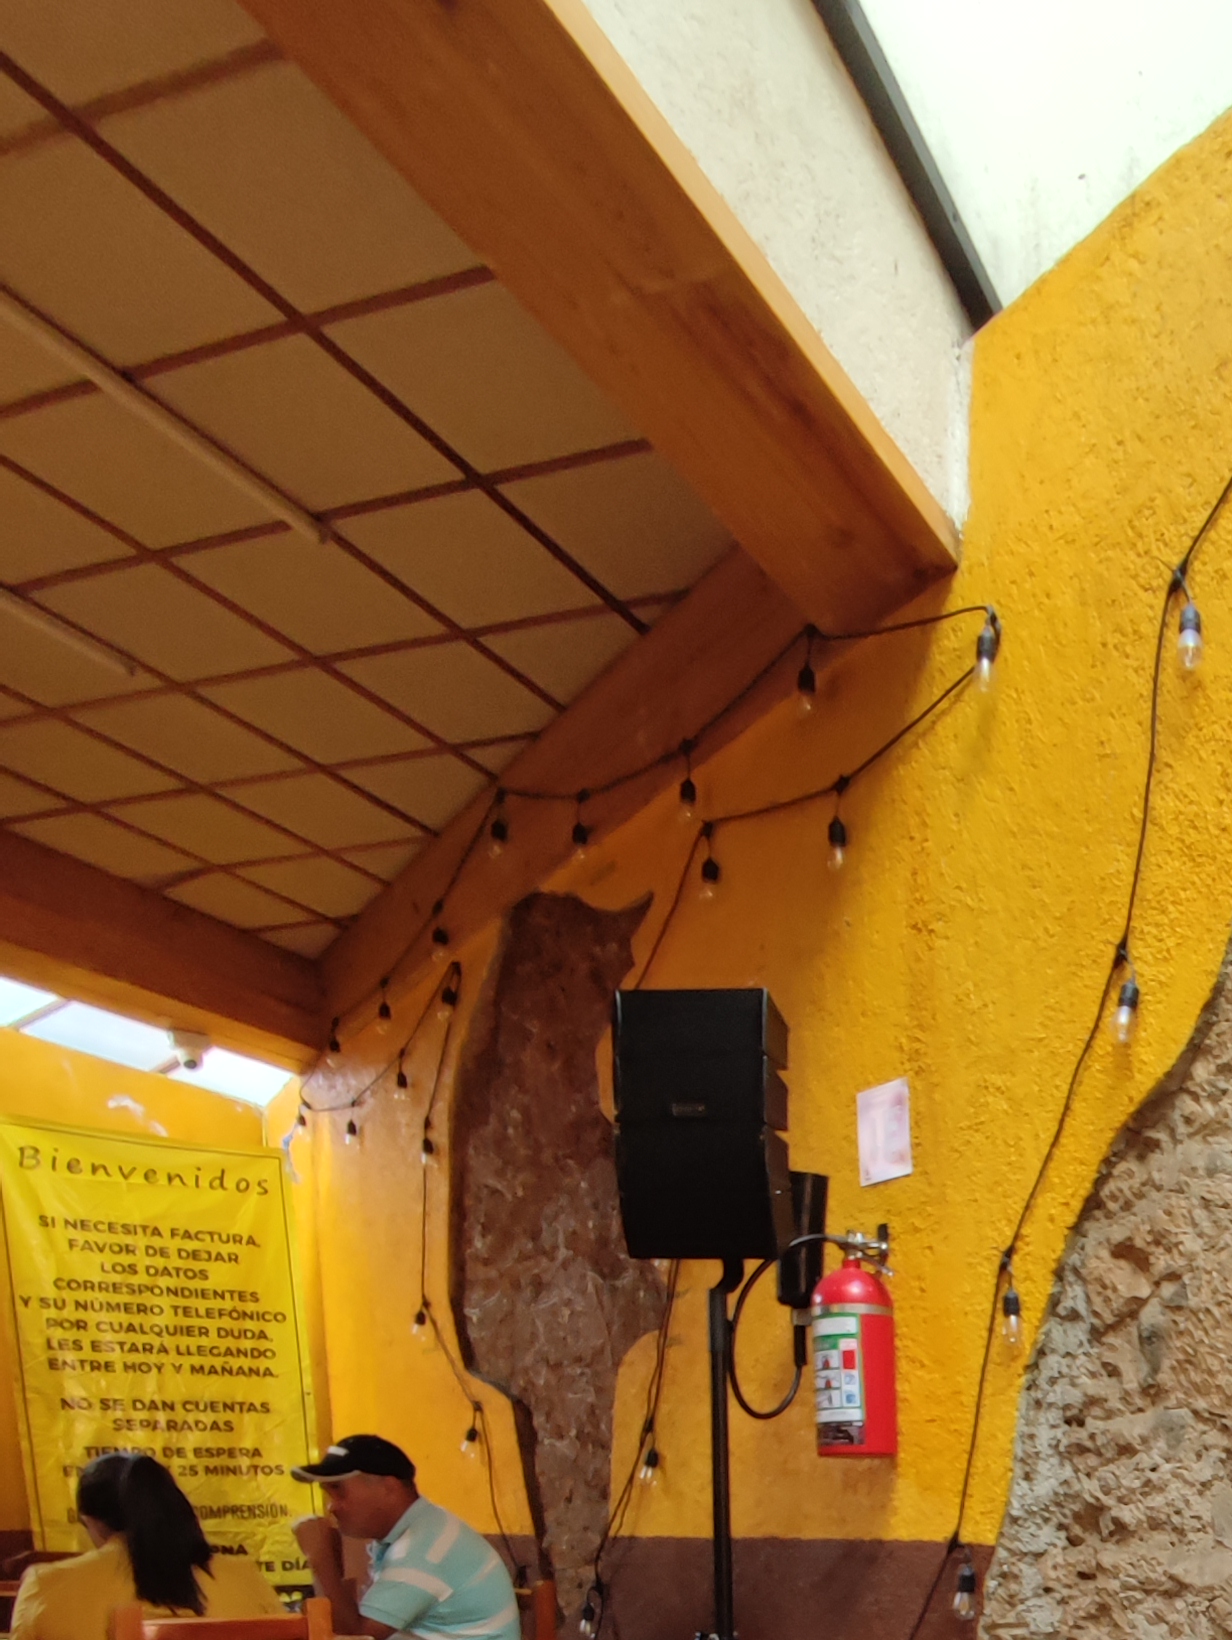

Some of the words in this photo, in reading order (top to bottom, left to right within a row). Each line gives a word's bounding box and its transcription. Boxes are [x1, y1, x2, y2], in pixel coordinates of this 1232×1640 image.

[18, 1145, 269, 1196] Bienvenidos
[38, 1214, 56, 1229] SI
[64, 1218, 164, 1239] NECESITA
[68, 1239, 138, 1257] FAVOR
[145, 1245, 171, 1259] DE
[177, 1249, 240, 1265] DEJAR
[100, 1262, 139, 1276] LOS
[145, 1265, 209, 1281] DATOS
[53, 1277, 260, 1303] CORRESPONDIENTES
[19, 1295, 31, 1309] Y
[39, 1297, 66, 1311] SU
[75, 1296, 164, 1317] NÚMERO
[171, 1305, 287, 1324] TELEFÓNICO
[45, 1317, 88, 1333] POR
[95, 1319, 210, 1338] CUALQUIER
[46, 1337, 84, 1352] LES
[90, 1339, 170, 1356] ESTARÁ
[175, 1344, 277, 1360] LLEGANDO
[48, 1357, 117, 1374] ENTRE
[123, 1360, 165, 1375] HOY
[171, 1363, 185, 1375] Y
[60, 1397, 92, 1411] NO
[99, 1398, 126, 1411] SE
[132, 1399, 175, 1413] DAN
[182, 1400, 271, 1415] CUENTAS
[112, 1418, 235, 1433] SEPARADAS
[162, 1447, 187, 1458] DE
[193, 1446, 263, 1459] ESPERA
[178, 1465, 199, 1477] 25
[204, 1465, 285, 1477] MINUTOS
[200, 1503, 292, 1521] OMPRENSIÓN.
